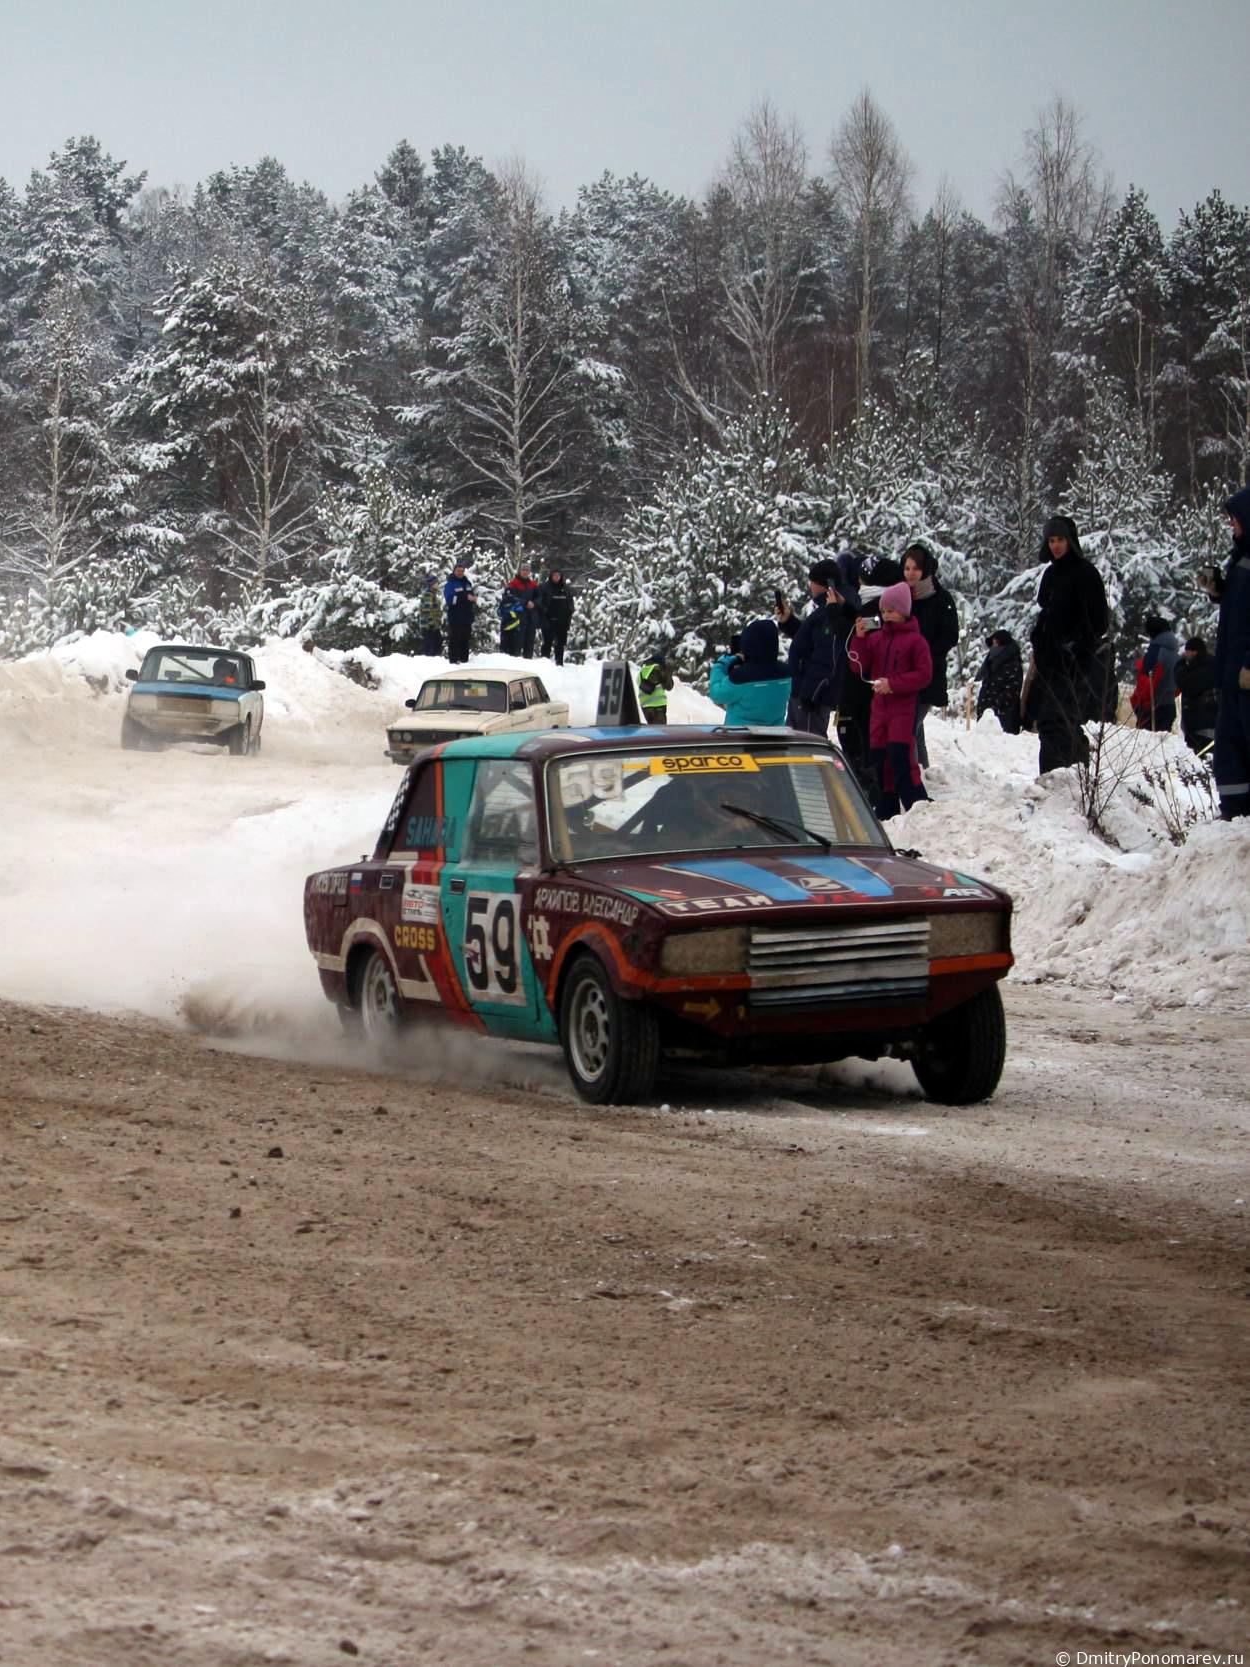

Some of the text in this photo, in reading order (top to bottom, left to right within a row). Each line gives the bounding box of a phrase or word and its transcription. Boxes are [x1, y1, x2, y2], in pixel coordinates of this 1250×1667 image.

[598, 668, 624, 716] 59
[662, 756, 743, 772] sparco
[559, 760, 622, 808] 59
[666, 894, 773, 912] TEAM
[394, 925, 435, 951] CROSS
[466, 896, 517, 994] 59
